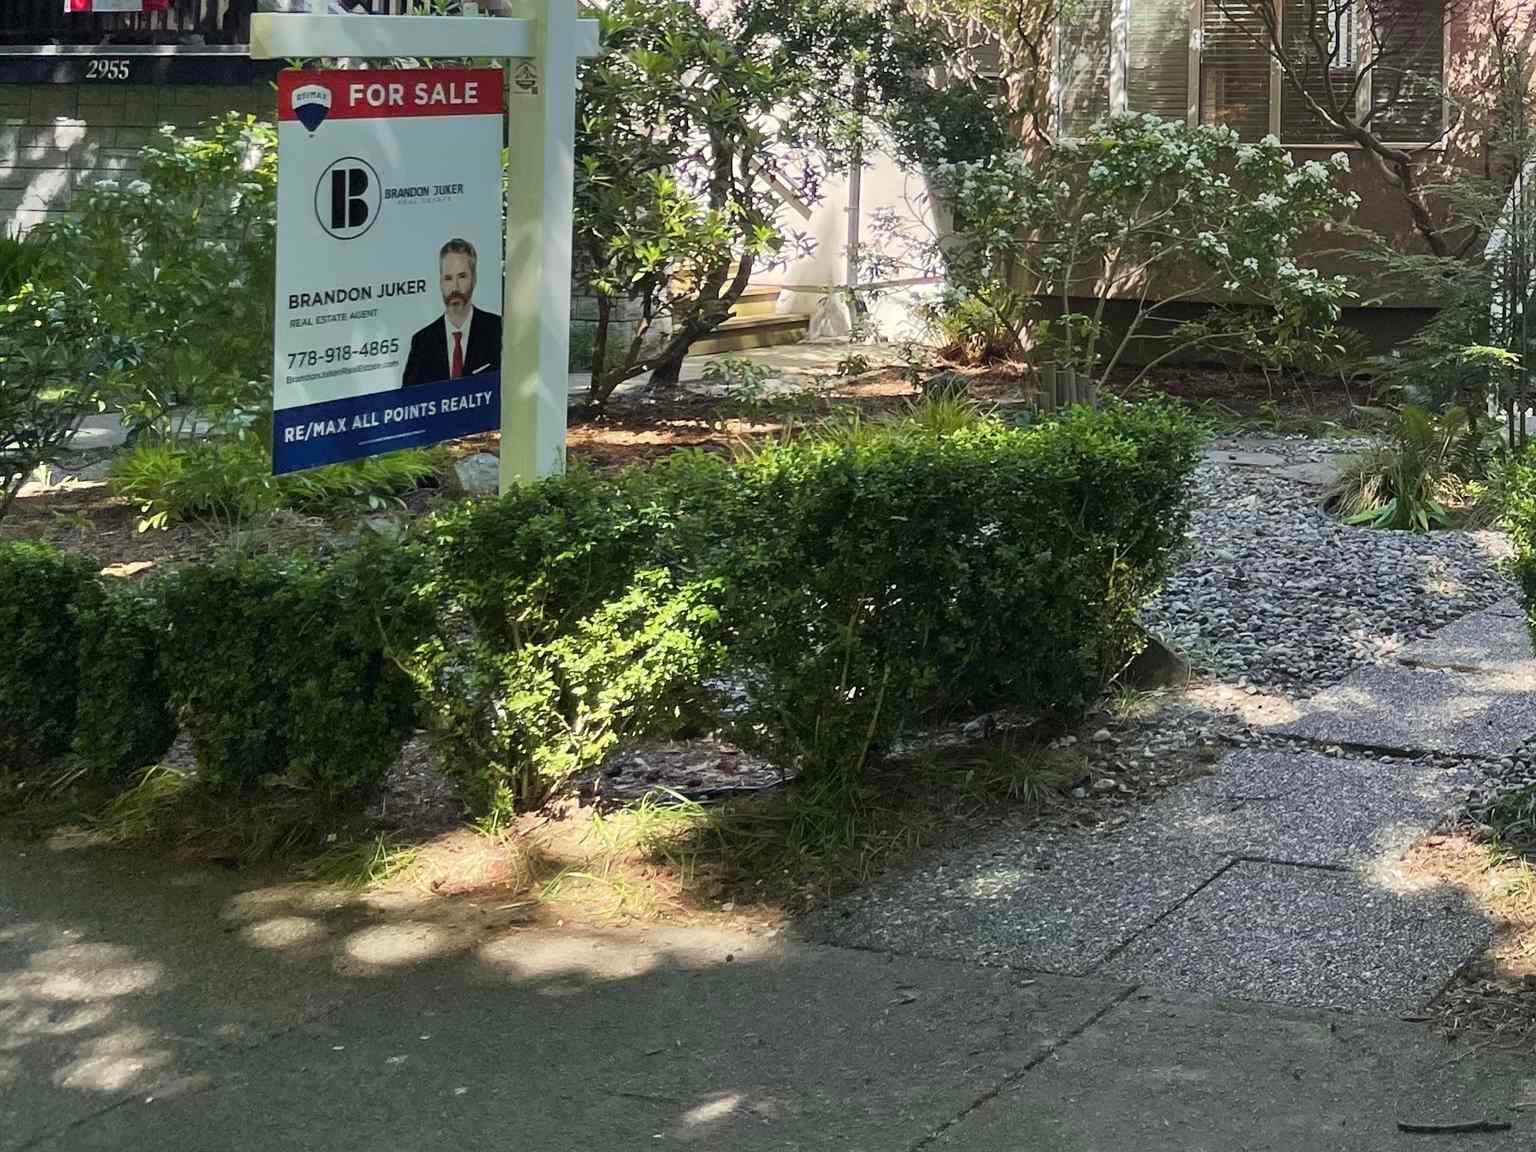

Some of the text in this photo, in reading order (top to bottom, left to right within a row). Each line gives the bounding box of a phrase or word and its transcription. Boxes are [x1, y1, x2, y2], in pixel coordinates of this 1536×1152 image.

[86, 59, 130, 79] 2955
[350, 82, 478, 106] FOR SALE
[384, 183, 464, 199] BRANDON JUKER
[288, 279, 426, 309] BRANDON JUKER
[289, 309, 378, 328] REAL ESTATE AGENT
[287, 338, 399, 369] 778-918-4865
[284, 391, 493, 442] RE/MAX ALL POINTS REALTY
